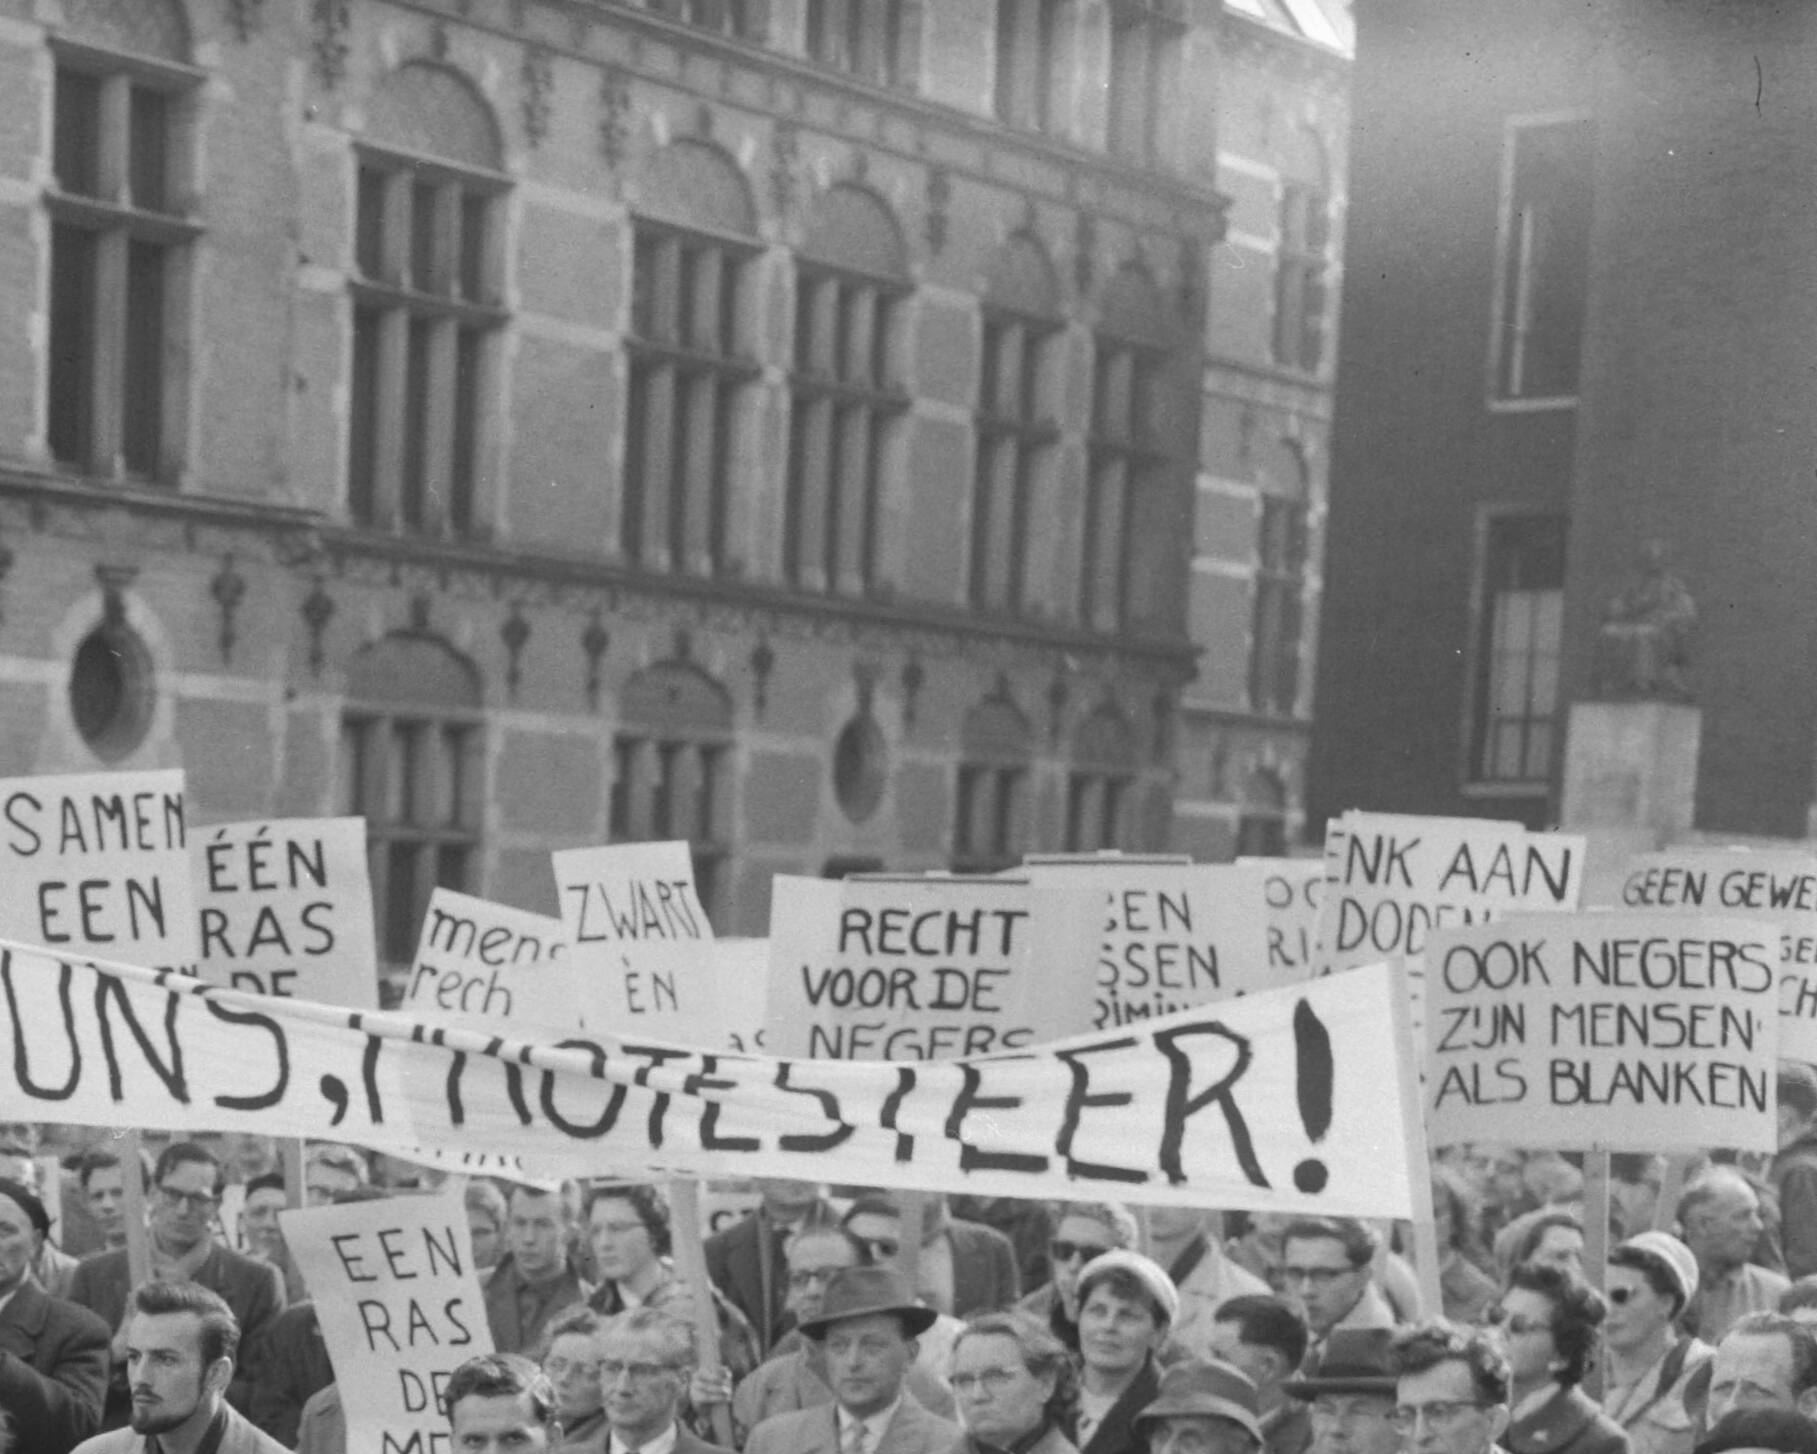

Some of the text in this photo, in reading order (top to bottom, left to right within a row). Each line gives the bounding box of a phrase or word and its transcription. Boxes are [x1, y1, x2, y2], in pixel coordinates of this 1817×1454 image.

[4, 792, 184, 856] SAMEN
[205, 825, 330, 893] ÉÉN
[1329, 832, 1572, 902] NK AAN
[38, 875, 166, 943] EEN
[566, 879, 703, 944] ZWART
[1622, 867, 1708, 908] GEEN
[198, 900, 336, 959] RAS
[838, 907, 1030, 956] RECHT
[802, 965, 1011, 1012] VOOR DE
[1442, 938, 1773, 994] OOK NEGERS
[1551, 1003, 1754, 1052] MENSEN
[1435, 1057, 1767, 1112] ALS BLANKEN
[330, 1226, 464, 1283] EEN
[357, 1298, 472, 1352] RAS
